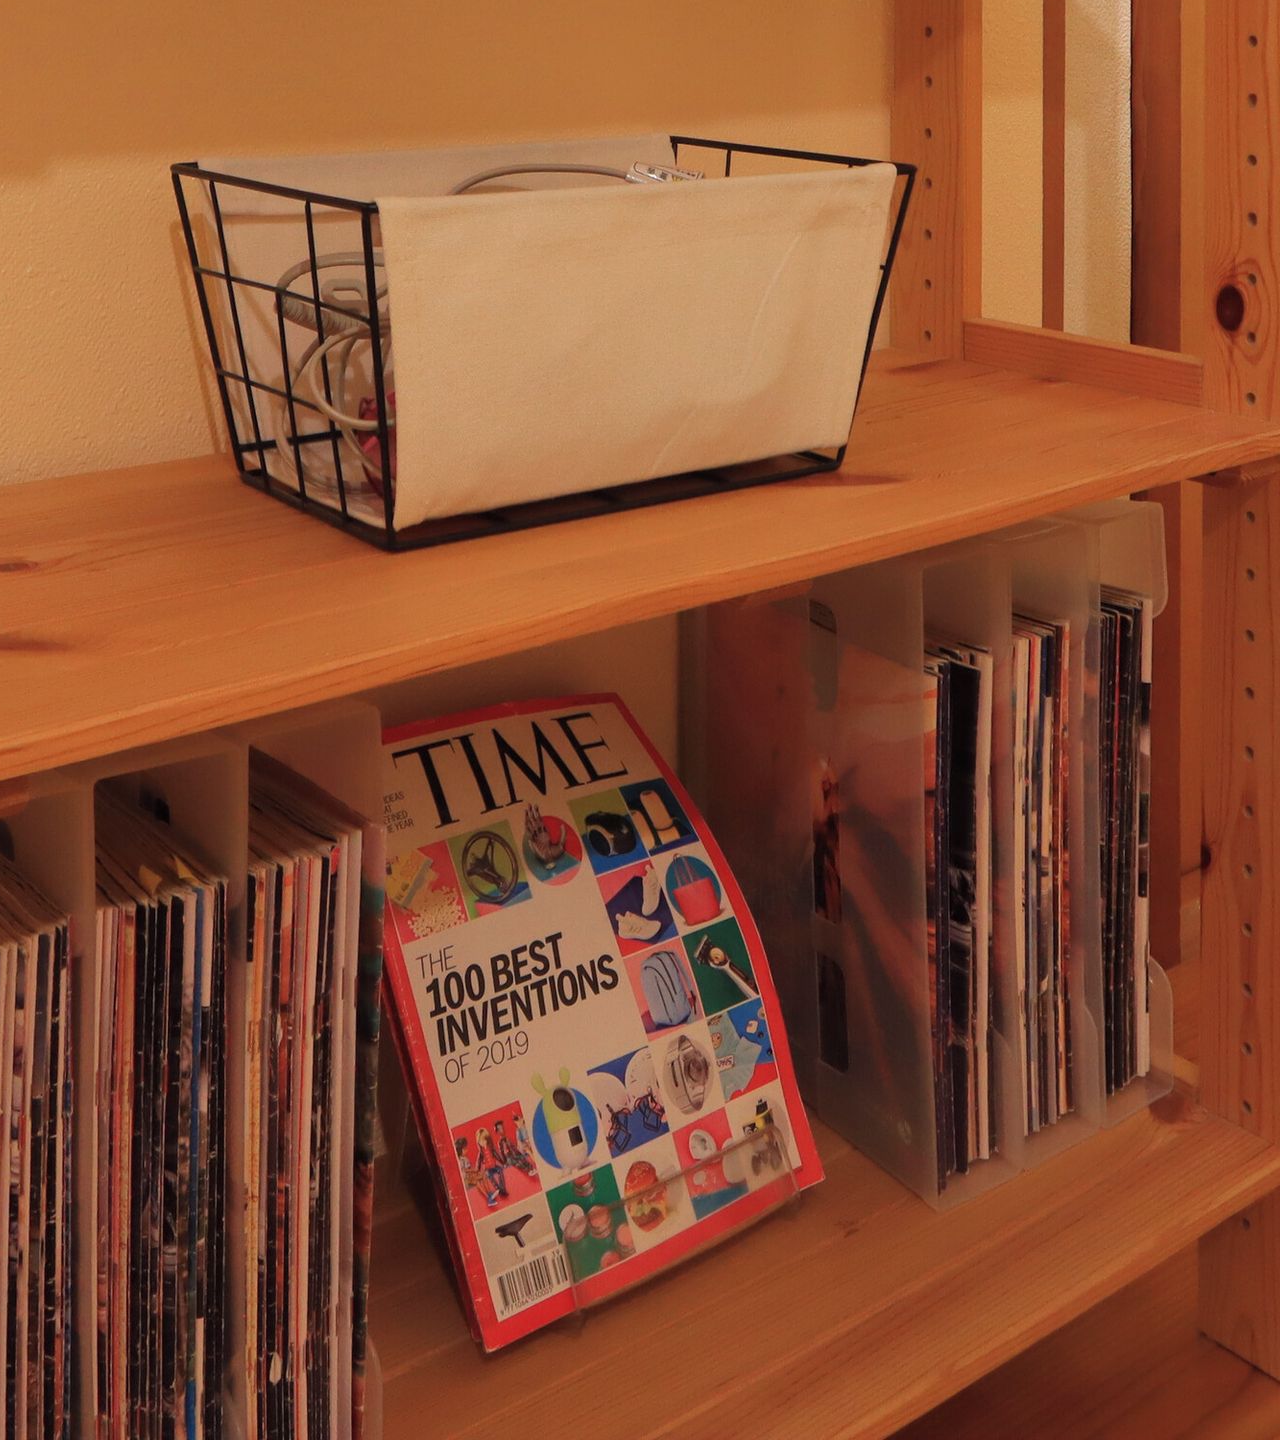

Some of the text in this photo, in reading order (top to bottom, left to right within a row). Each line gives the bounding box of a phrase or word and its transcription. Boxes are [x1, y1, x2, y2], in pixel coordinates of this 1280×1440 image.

[391, 711, 629, 829] TIME
[415, 944, 457, 979] THE
[425, 932, 563, 1018] 100 BEST
[435, 953, 620, 1057] INVENTIONS
[444, 1030, 530, 1083] OF 2019
